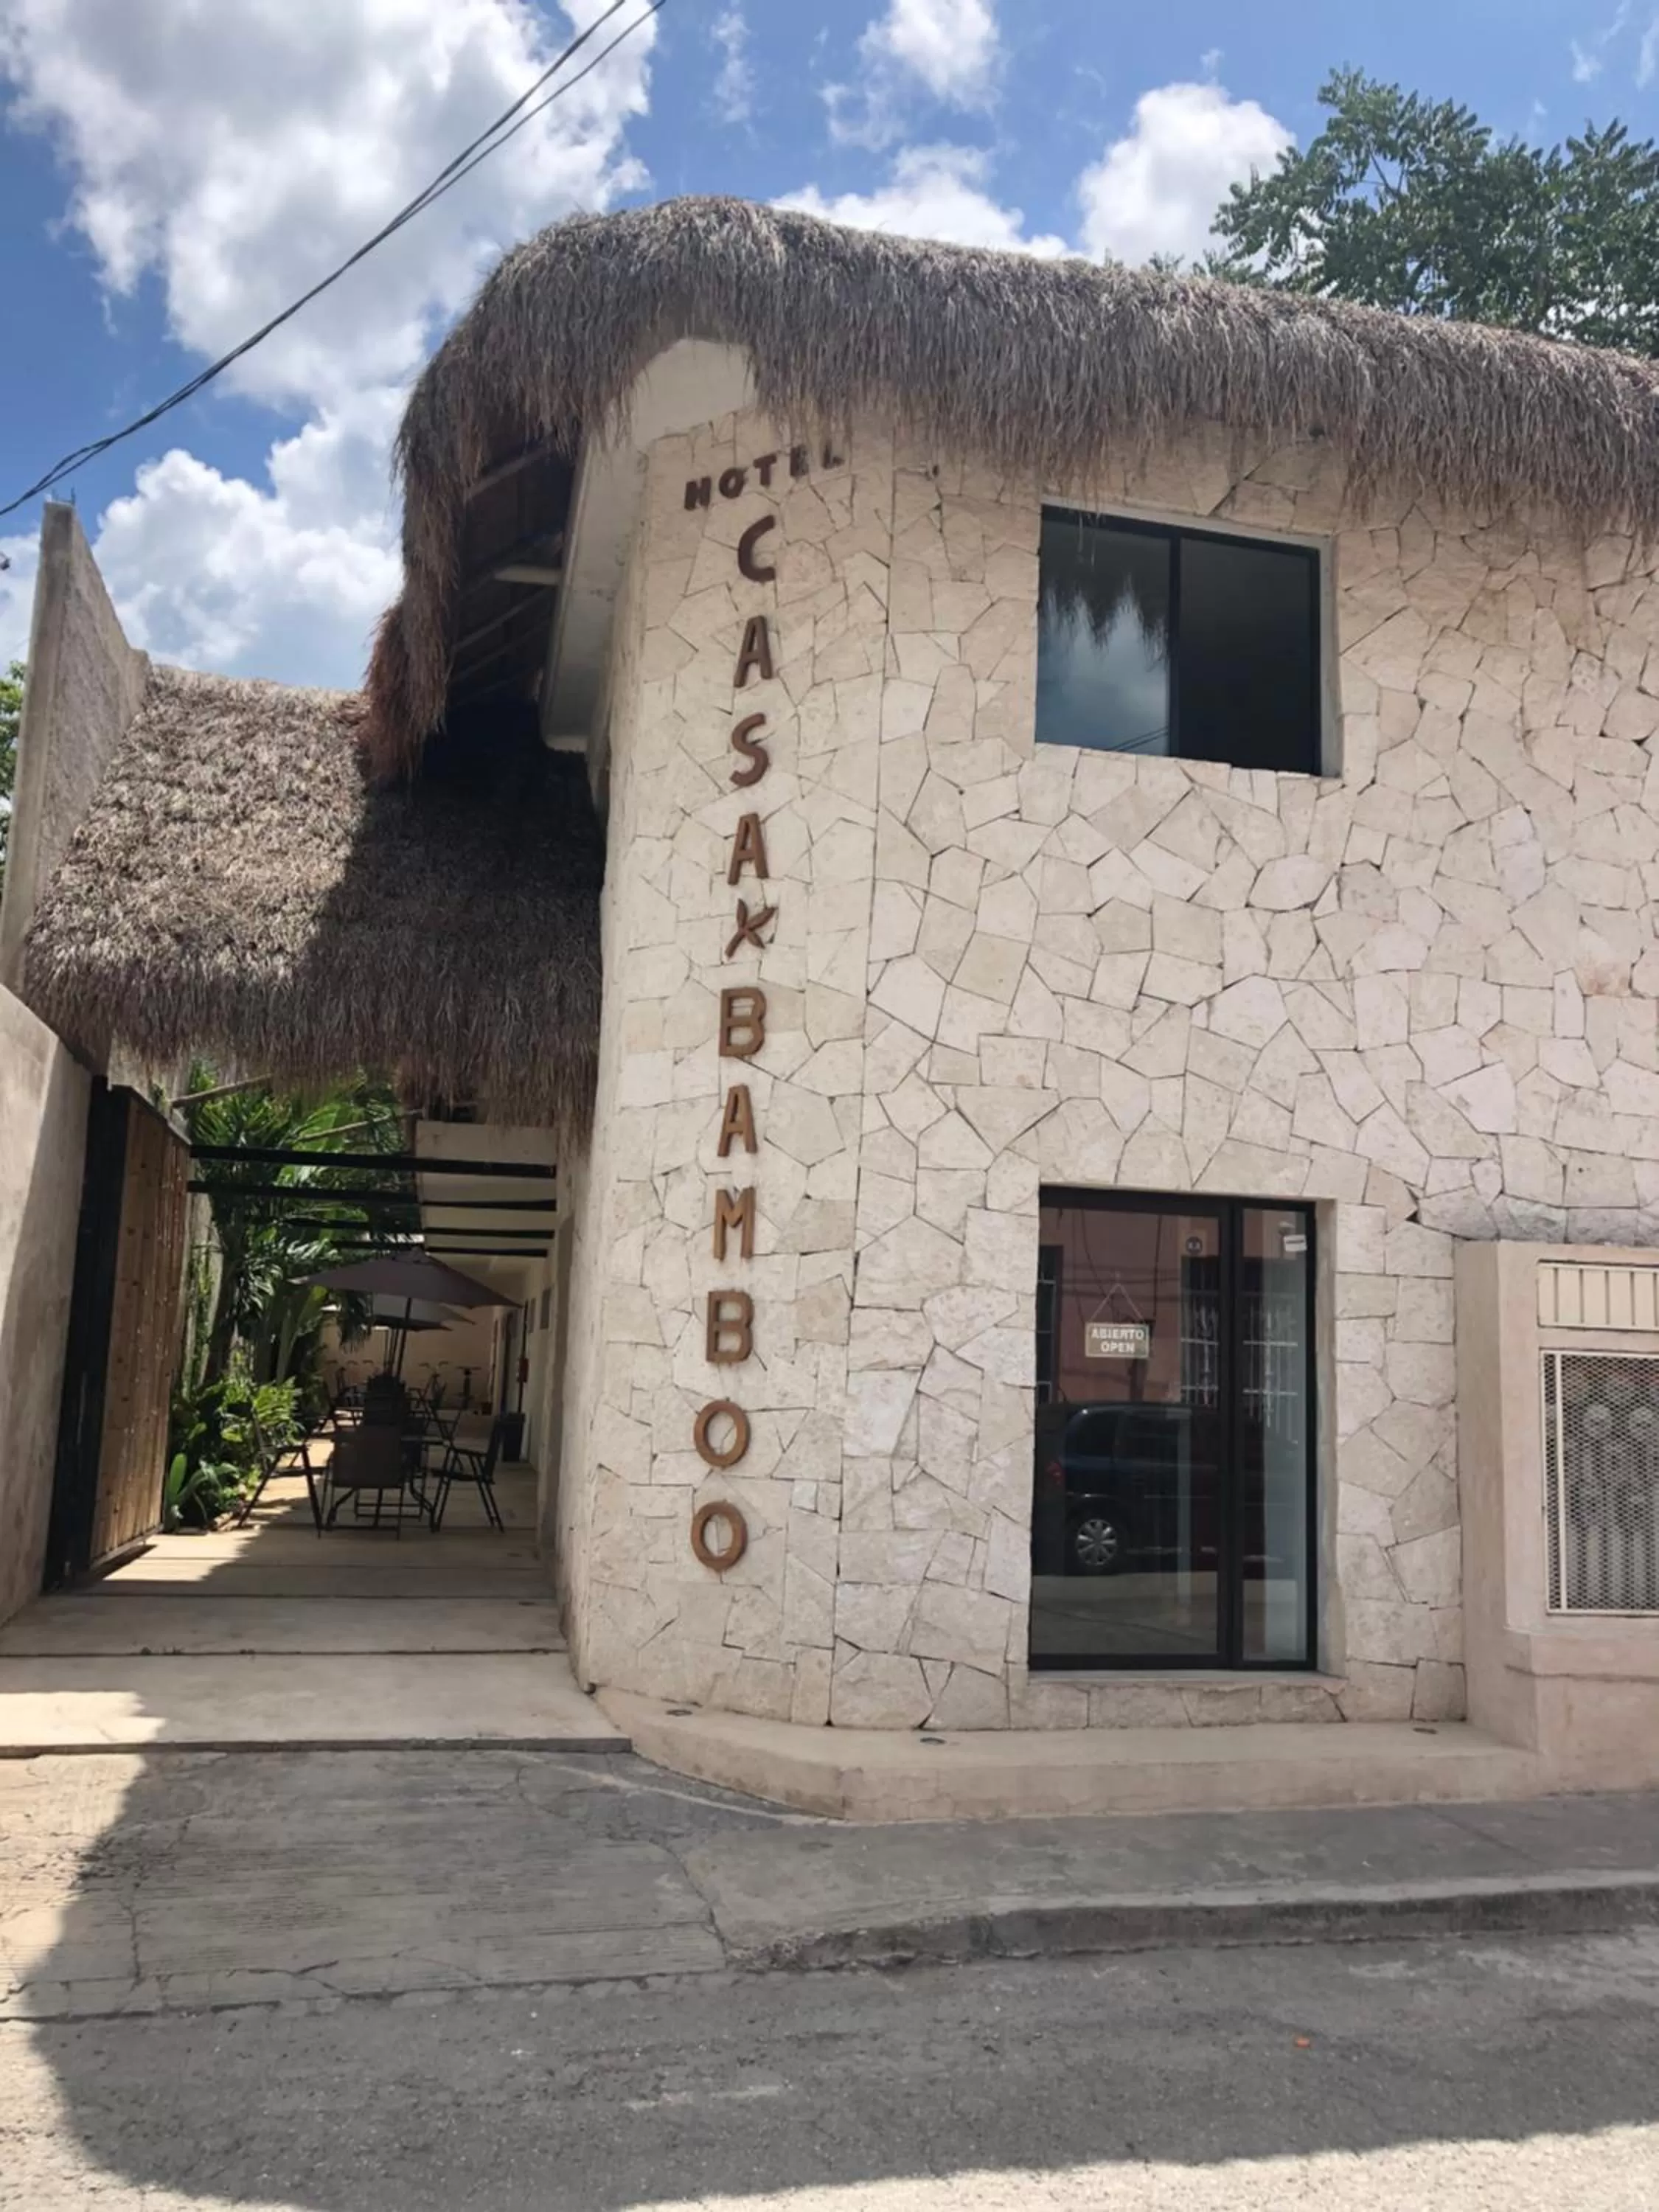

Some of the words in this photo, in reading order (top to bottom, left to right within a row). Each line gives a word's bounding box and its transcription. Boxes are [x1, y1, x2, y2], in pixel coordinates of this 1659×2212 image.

[684, 442, 845, 510] HOTEL
[1091, 1328, 1144, 1340] ABIERTO
[1100, 1341, 1135, 1353] OPEN
